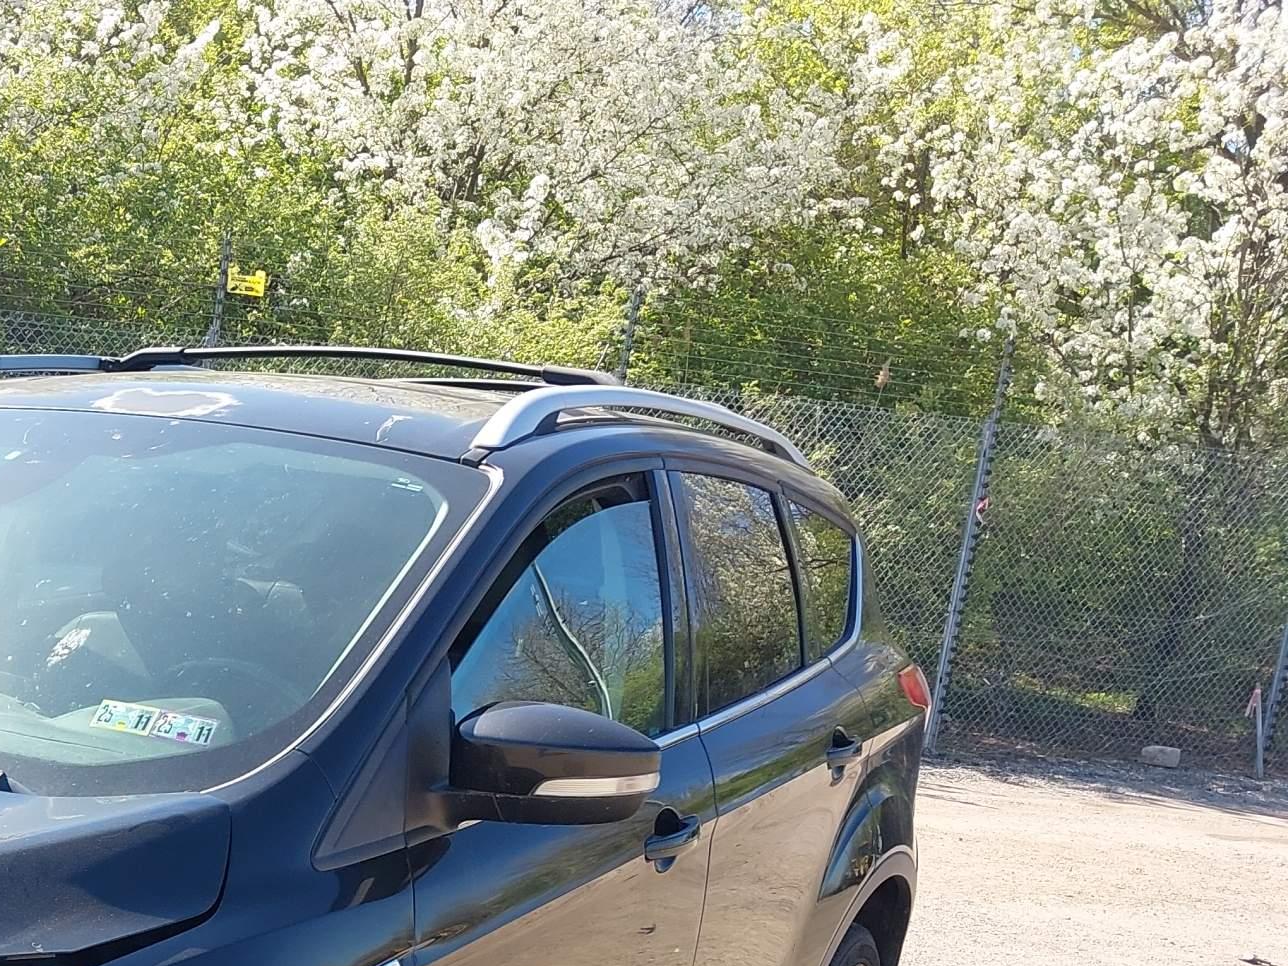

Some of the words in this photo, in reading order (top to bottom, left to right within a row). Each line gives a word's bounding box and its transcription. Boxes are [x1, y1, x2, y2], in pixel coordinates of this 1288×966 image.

[97, 704, 114, 723] 25
[134, 714, 152, 731] 11
[157, 714, 173, 734] 25
[195, 726, 213, 743] 11
